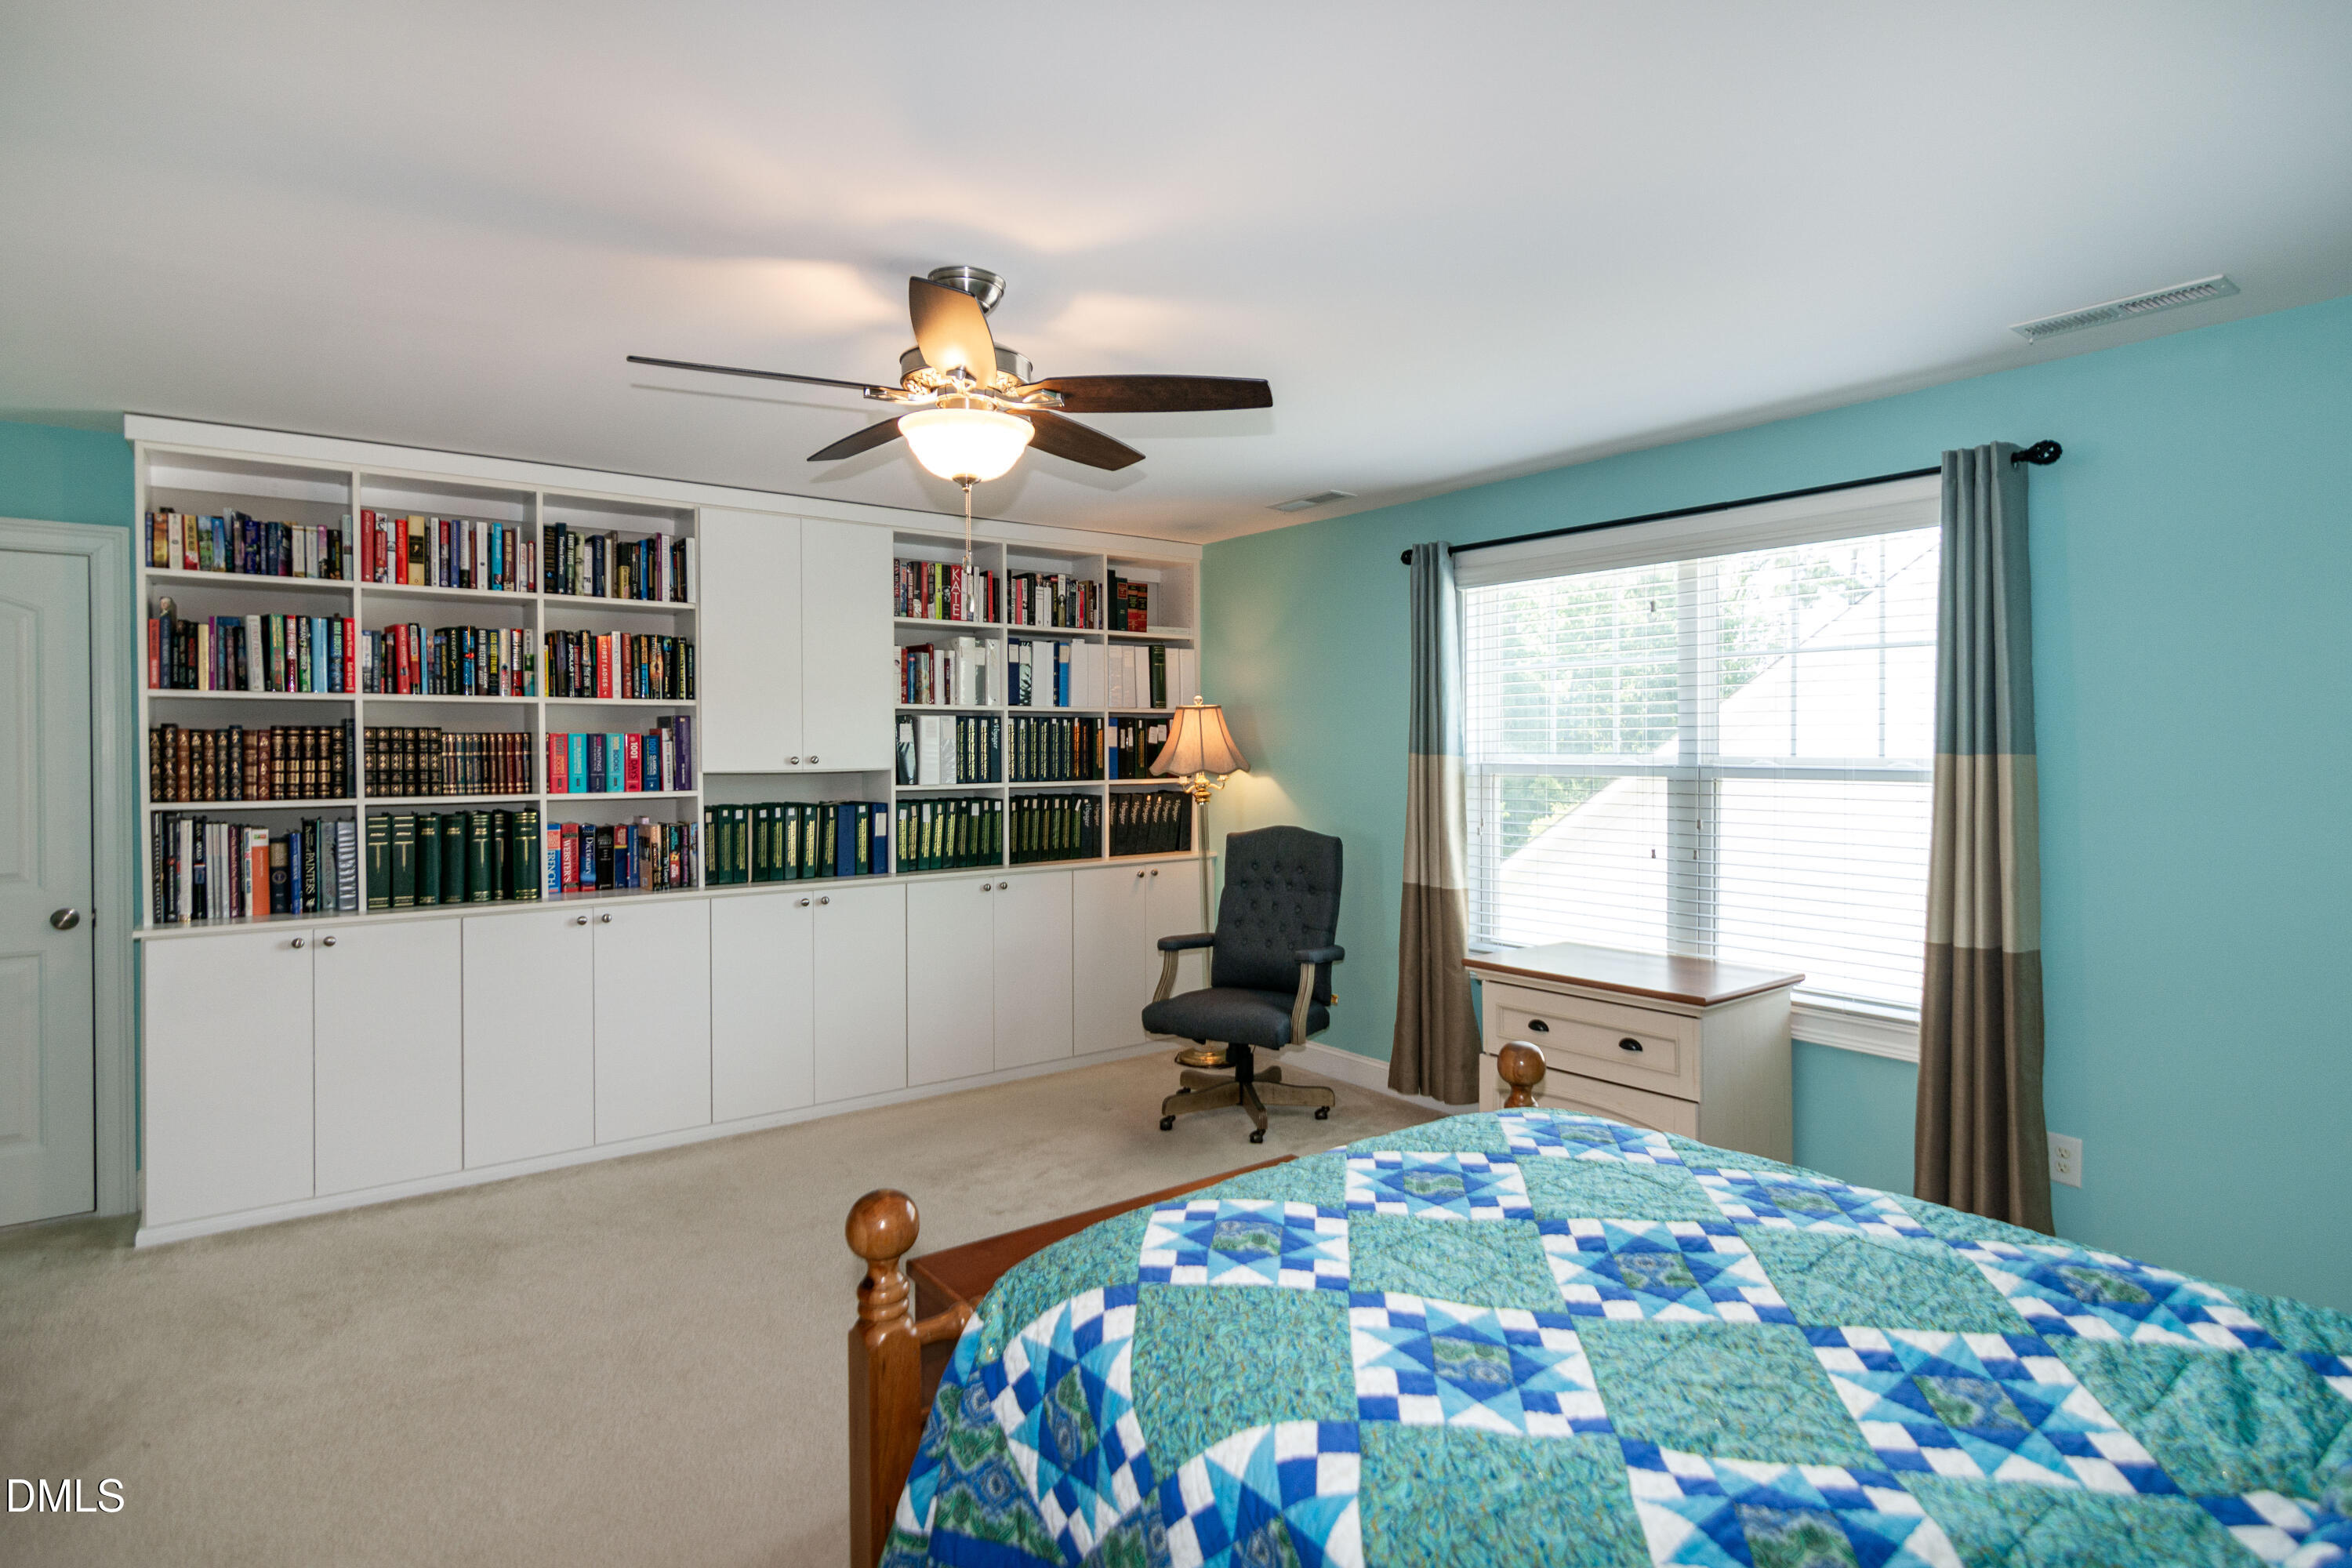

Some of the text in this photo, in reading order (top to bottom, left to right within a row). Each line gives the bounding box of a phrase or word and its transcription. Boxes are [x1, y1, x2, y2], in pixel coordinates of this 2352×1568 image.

[951, 568, 961, 616] KATE
[556, 736, 564, 755] 1001
[991, 724, 1000, 750] Voyager
[630, 742, 639, 759] 1001
[1083, 803, 1092, 827] Voyager
[1120, 800, 1128, 825] Voyager
[1131, 800, 1140, 825] Voyager
[1142, 800, 1151, 824] Voyager
[1153, 800, 1162, 823] Voyager
[1163, 800, 1171, 822] Voyager
[1172, 799, 1181, 822] Voyager
[547, 850, 556, 885] FRENCH
[563, 839, 572, 883] WEBSTER'S
[583, 837, 594, 875] Dictionary
[305, 852, 315, 895] PAINTERS
